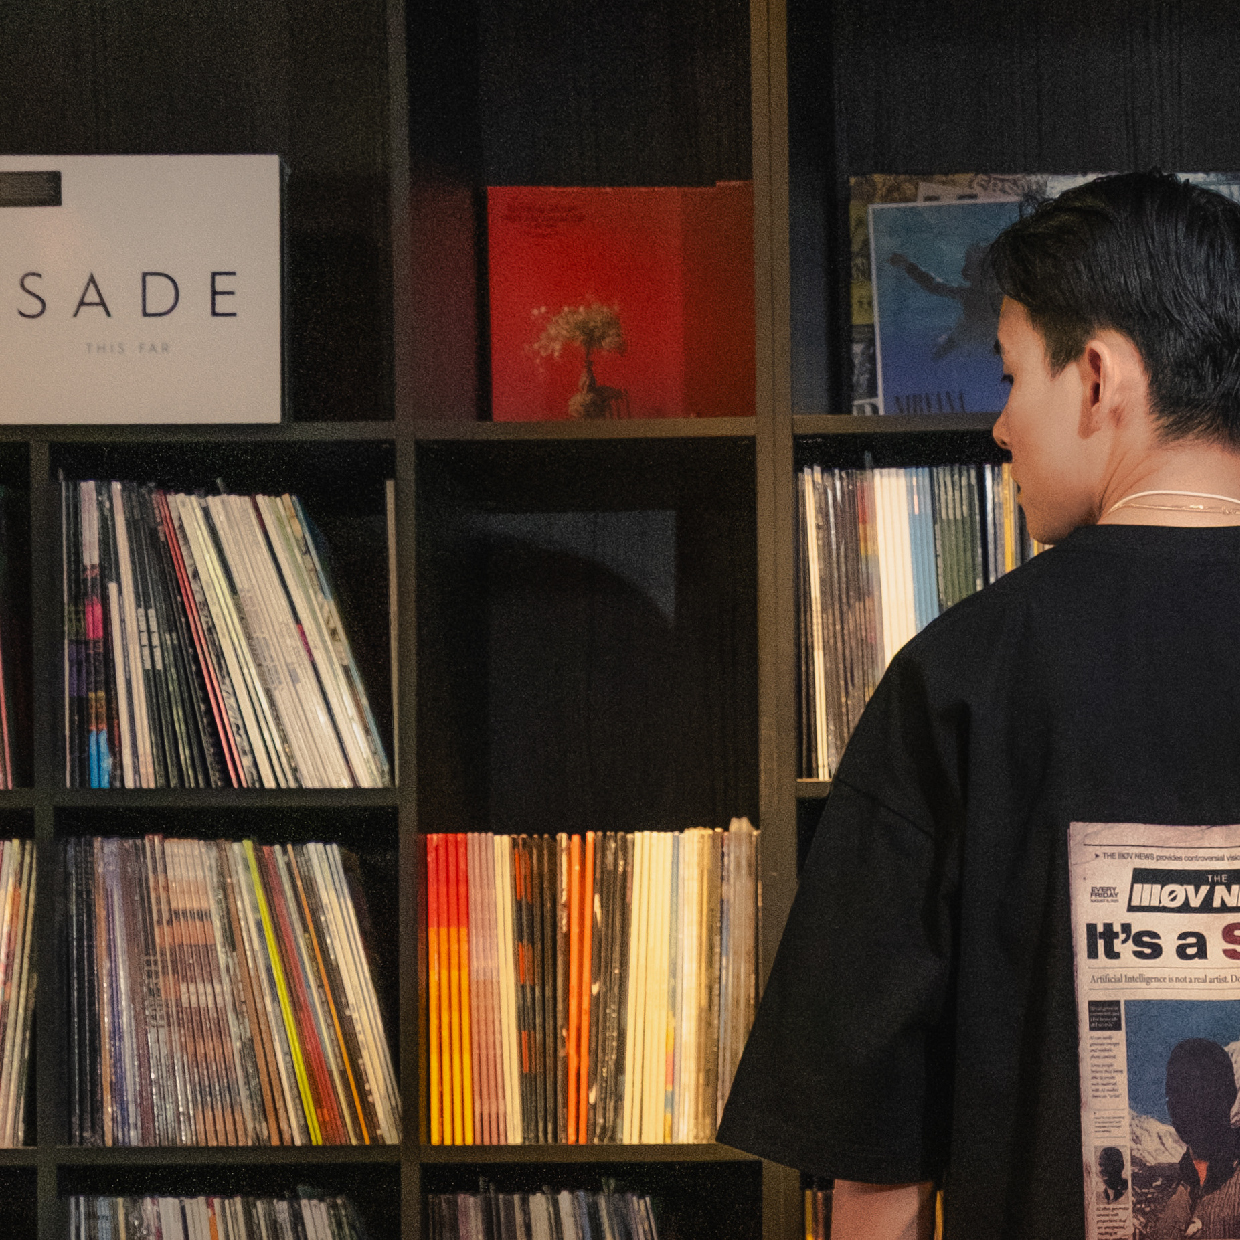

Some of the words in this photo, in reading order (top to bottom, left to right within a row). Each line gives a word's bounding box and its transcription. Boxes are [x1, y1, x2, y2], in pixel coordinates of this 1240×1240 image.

[17, 271, 238, 319] SADE
[86, 343, 125, 354] THIS
[138, 343, 170, 354] FAR
[1156, 854, 1182, 862] provides
[1206, 874, 1228, 883] THE
[1175, 930, 1208, 960] a
[1090, 973, 1123, 984] Artificial
[1124, 973, 1167, 986] Intelligence
[1168, 974, 1174, 984] is
[1174, 974, 1187, 984] not
[1188, 976, 1193, 984] a
[1193, 974, 1207, 984] real
[1208, 973, 1230, 984] artist.
